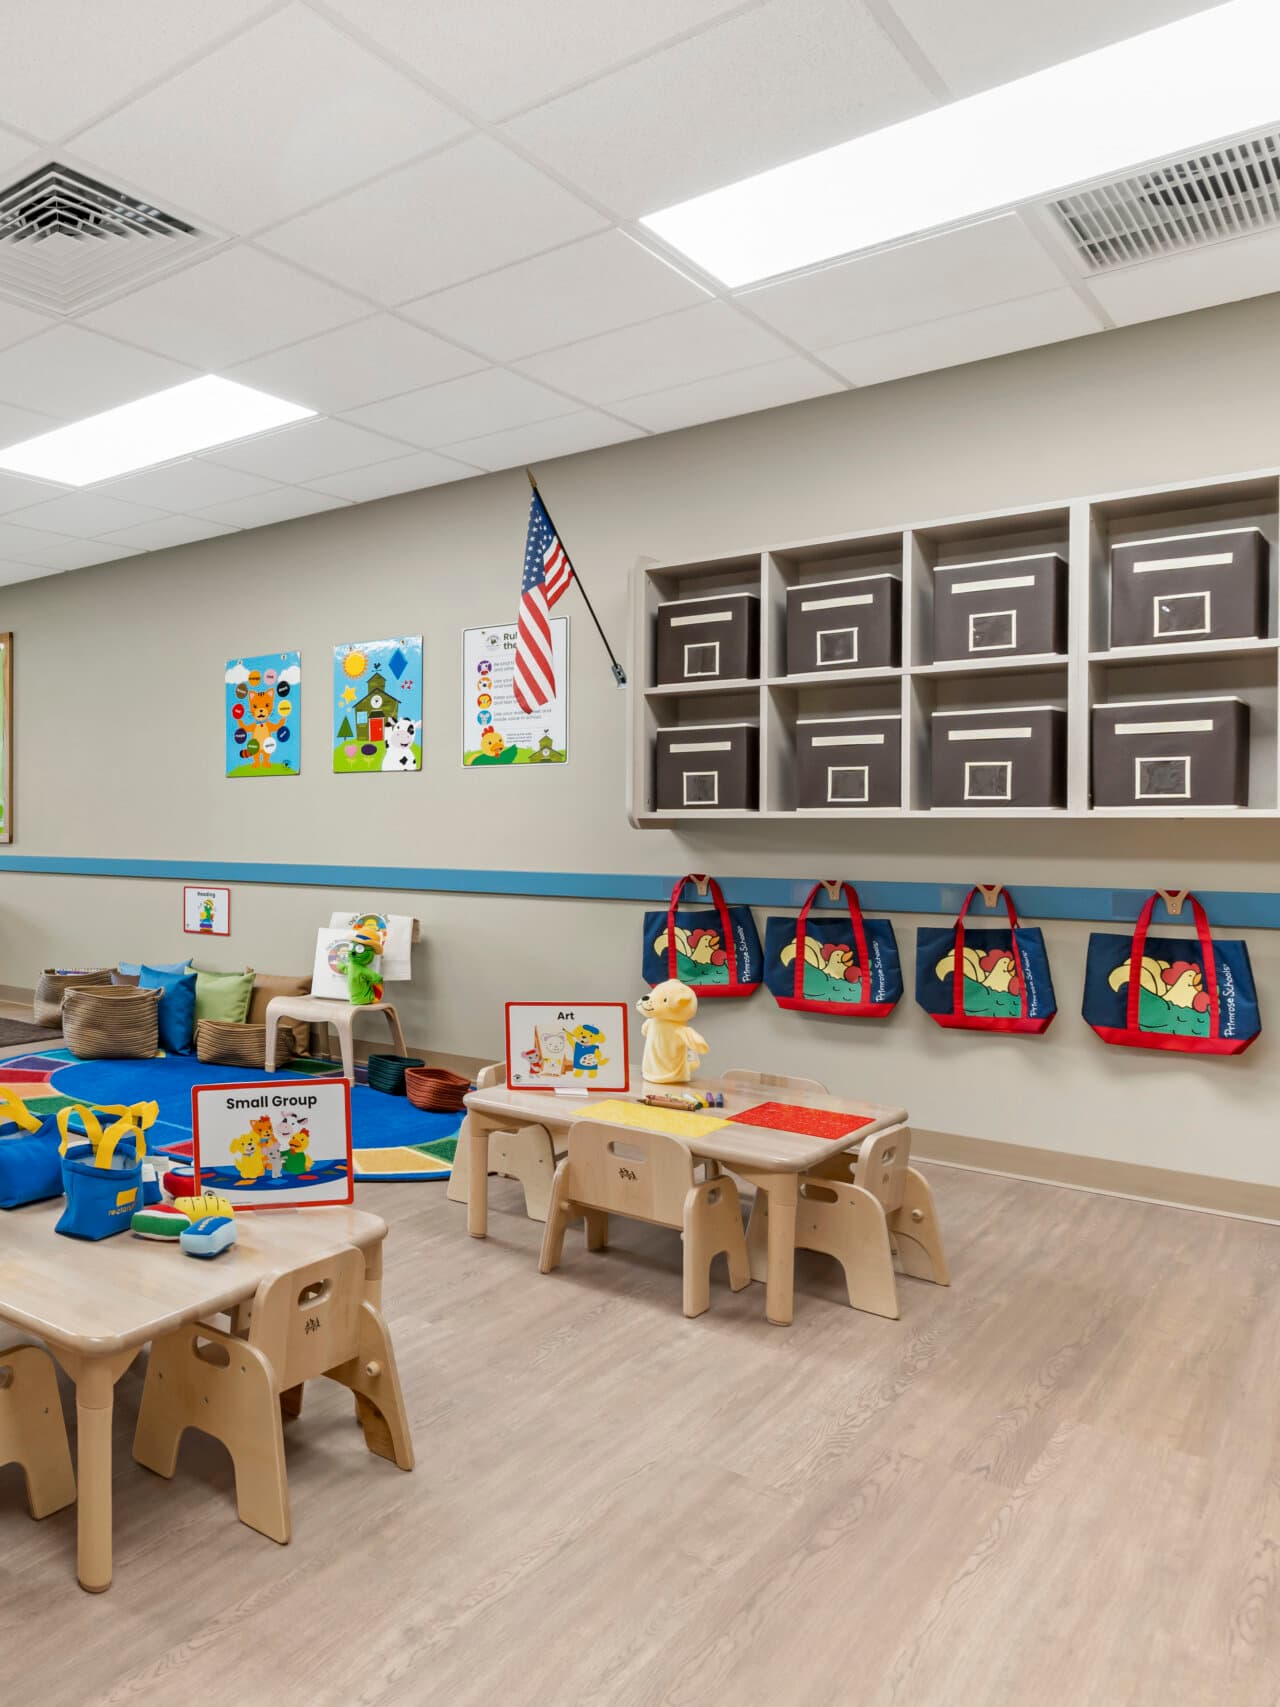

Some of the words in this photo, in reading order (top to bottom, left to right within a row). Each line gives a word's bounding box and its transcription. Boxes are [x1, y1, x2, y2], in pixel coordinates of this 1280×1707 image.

[737, 925, 749, 952] Schools
[742, 951, 752, 983] Primrose
[872, 940, 883, 969] Schools
[875, 969, 886, 1003] Primrose
[1222, 965, 1236, 998] Schools
[557, 1011, 575, 1020] Art
[1223, 998, 1236, 1037] Primrose
[226, 1095, 269, 1109] Small
[271, 1095, 318, 1109] Group
